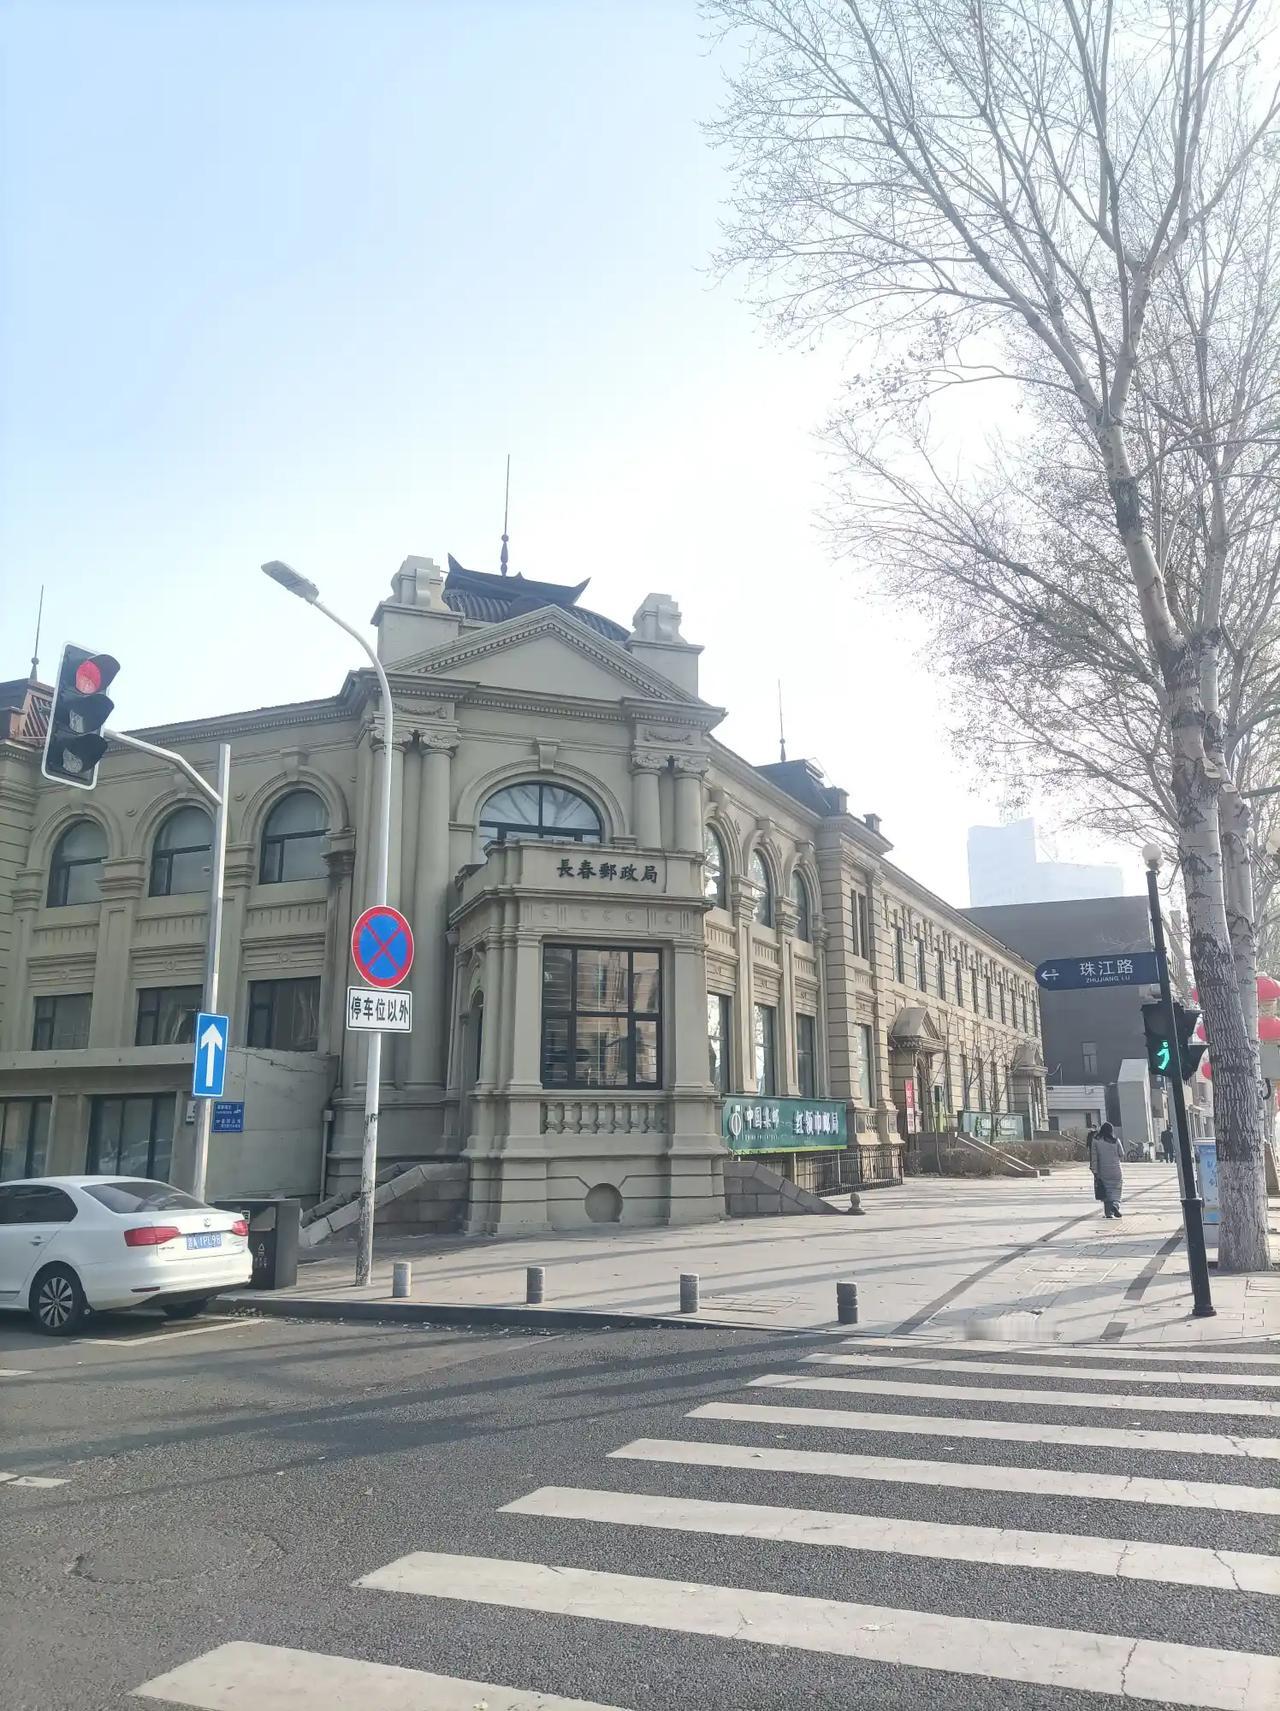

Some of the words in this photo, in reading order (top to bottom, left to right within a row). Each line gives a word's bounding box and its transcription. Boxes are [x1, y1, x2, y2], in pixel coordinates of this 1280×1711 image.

[557, 859, 658, 883] 長春郵政局
[1080, 959, 1133, 976] 珠江路
[1086, 975, 1118, 983] ZHUJIANG
[351, 996, 409, 1023] 停车位以外
[746, 1105, 779, 1129] 中国集邮
